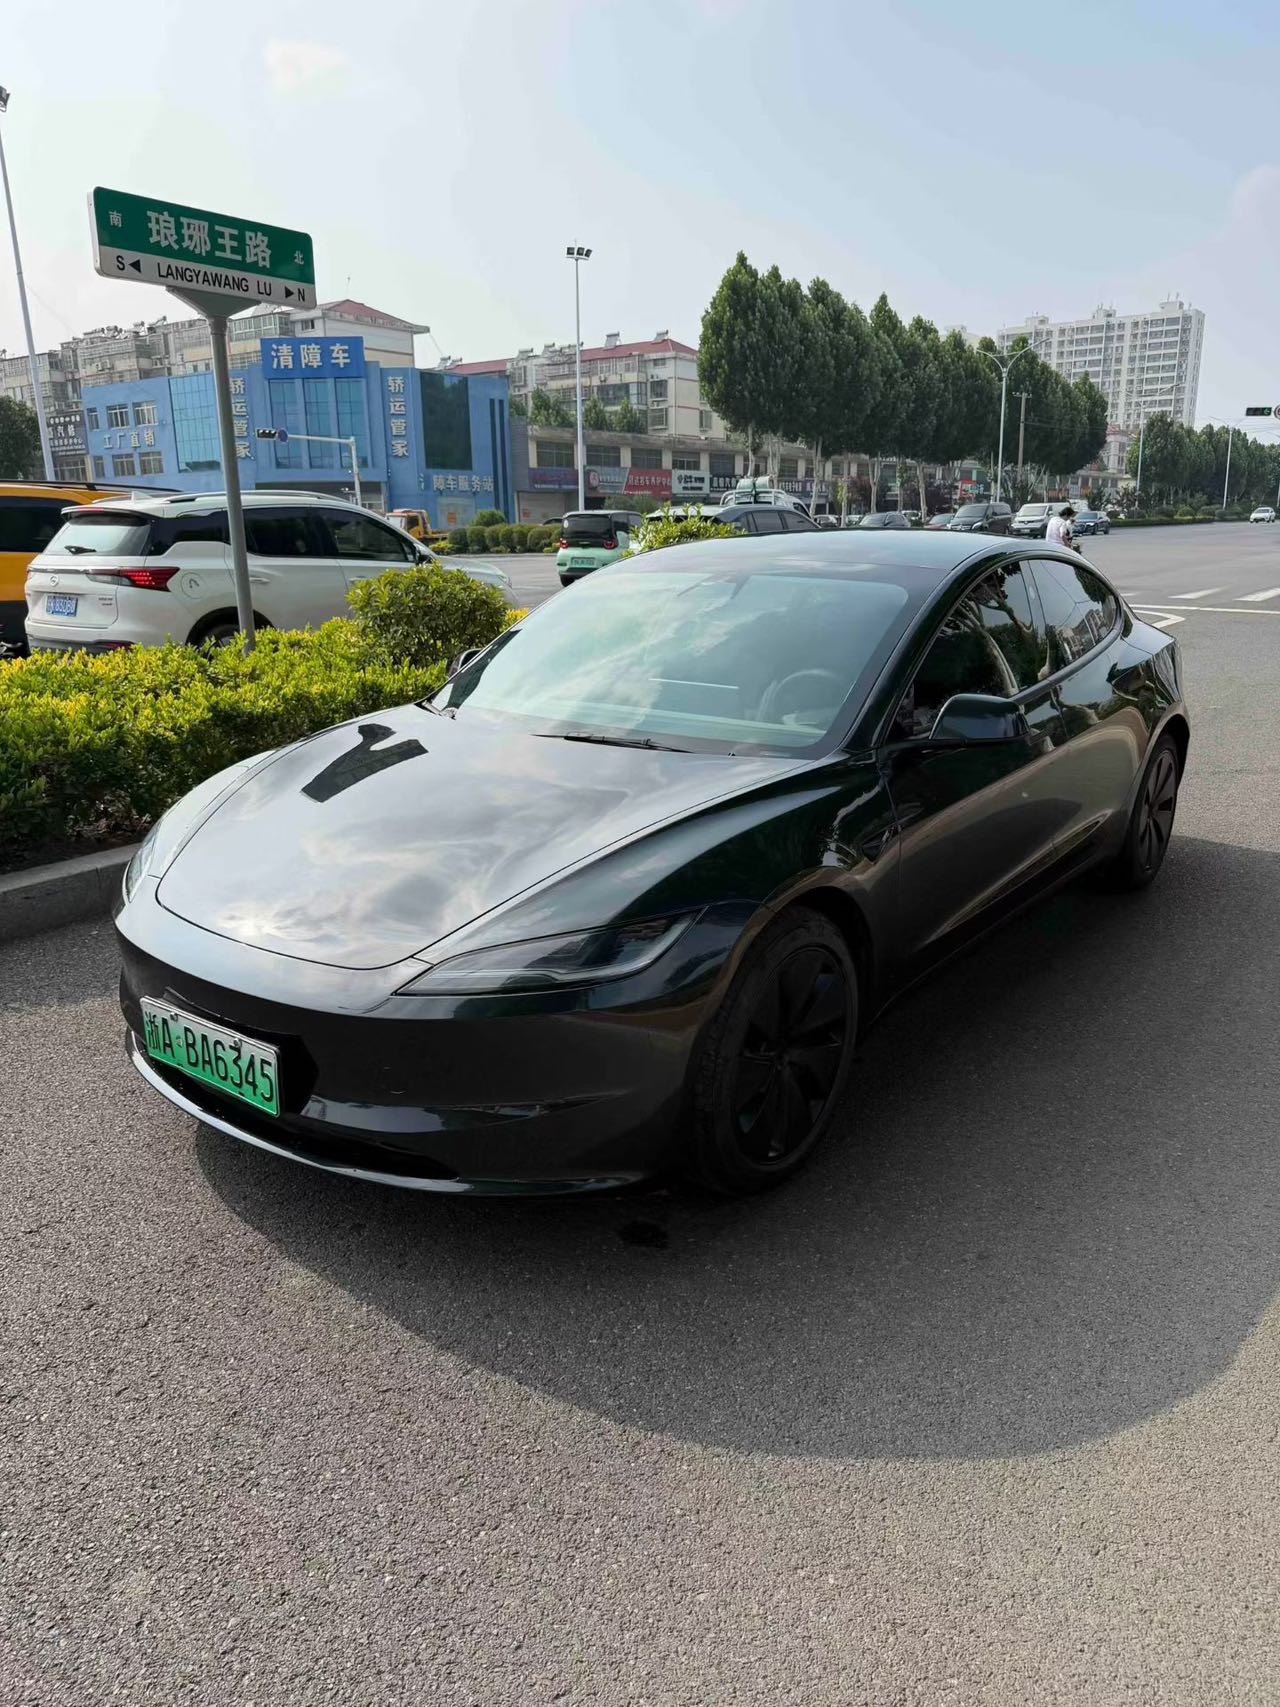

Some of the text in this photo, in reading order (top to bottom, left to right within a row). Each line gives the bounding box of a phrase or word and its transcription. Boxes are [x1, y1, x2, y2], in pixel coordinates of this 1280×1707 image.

[108, 211, 122, 228] 南
[294, 250, 304, 265] 北
[116, 255, 306, 301] S LANGYAWANG LU N
[271, 343, 350, 369] 清障车
[387, 376, 409, 457] 轿运管家
[103, 431, 156, 449] 工厂直销
[418, 473, 494, 493] 障车服务站
